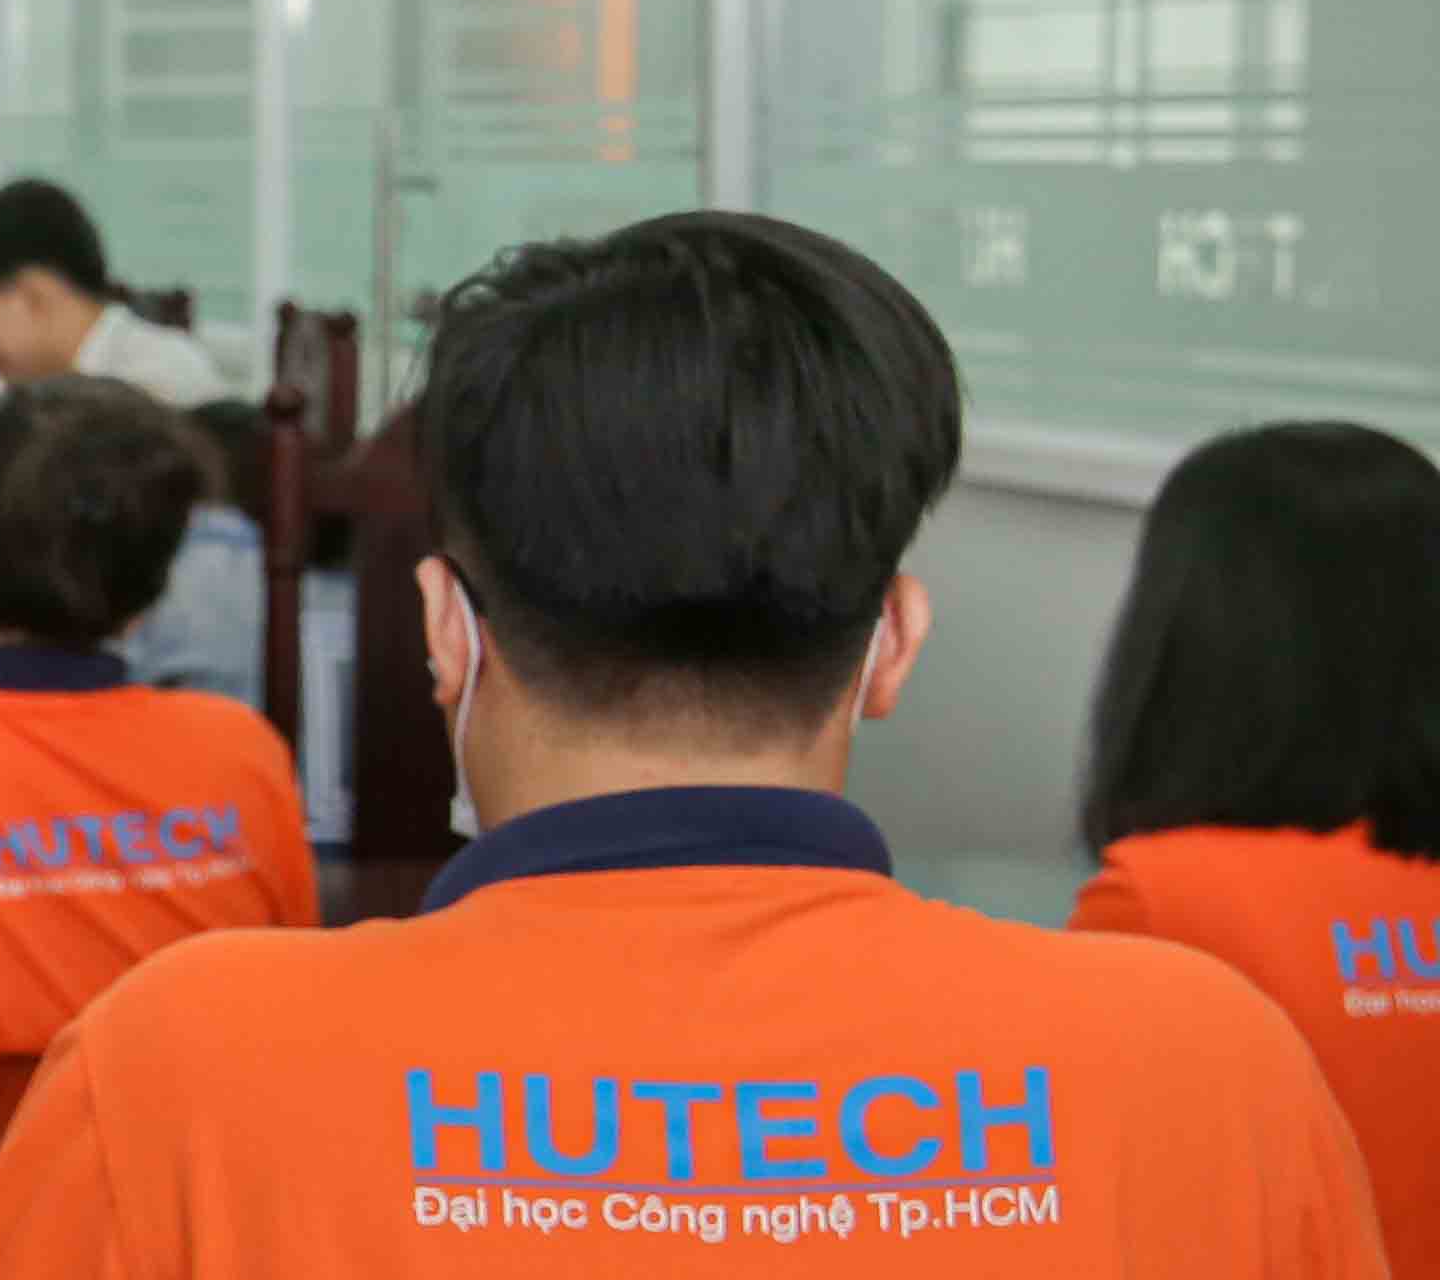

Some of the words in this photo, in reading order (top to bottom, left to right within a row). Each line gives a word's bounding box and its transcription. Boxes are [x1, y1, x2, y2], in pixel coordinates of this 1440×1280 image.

[405, 1066, 1057, 1181] HUTECH
[412, 1187, 488, 1233] Đại
[503, 1188, 588, 1233] học
[601, 1192, 726, 1244] Công
[741, 1193, 856, 1244] nghệ
[866, 1186, 1060, 1238] Tp.HCM
